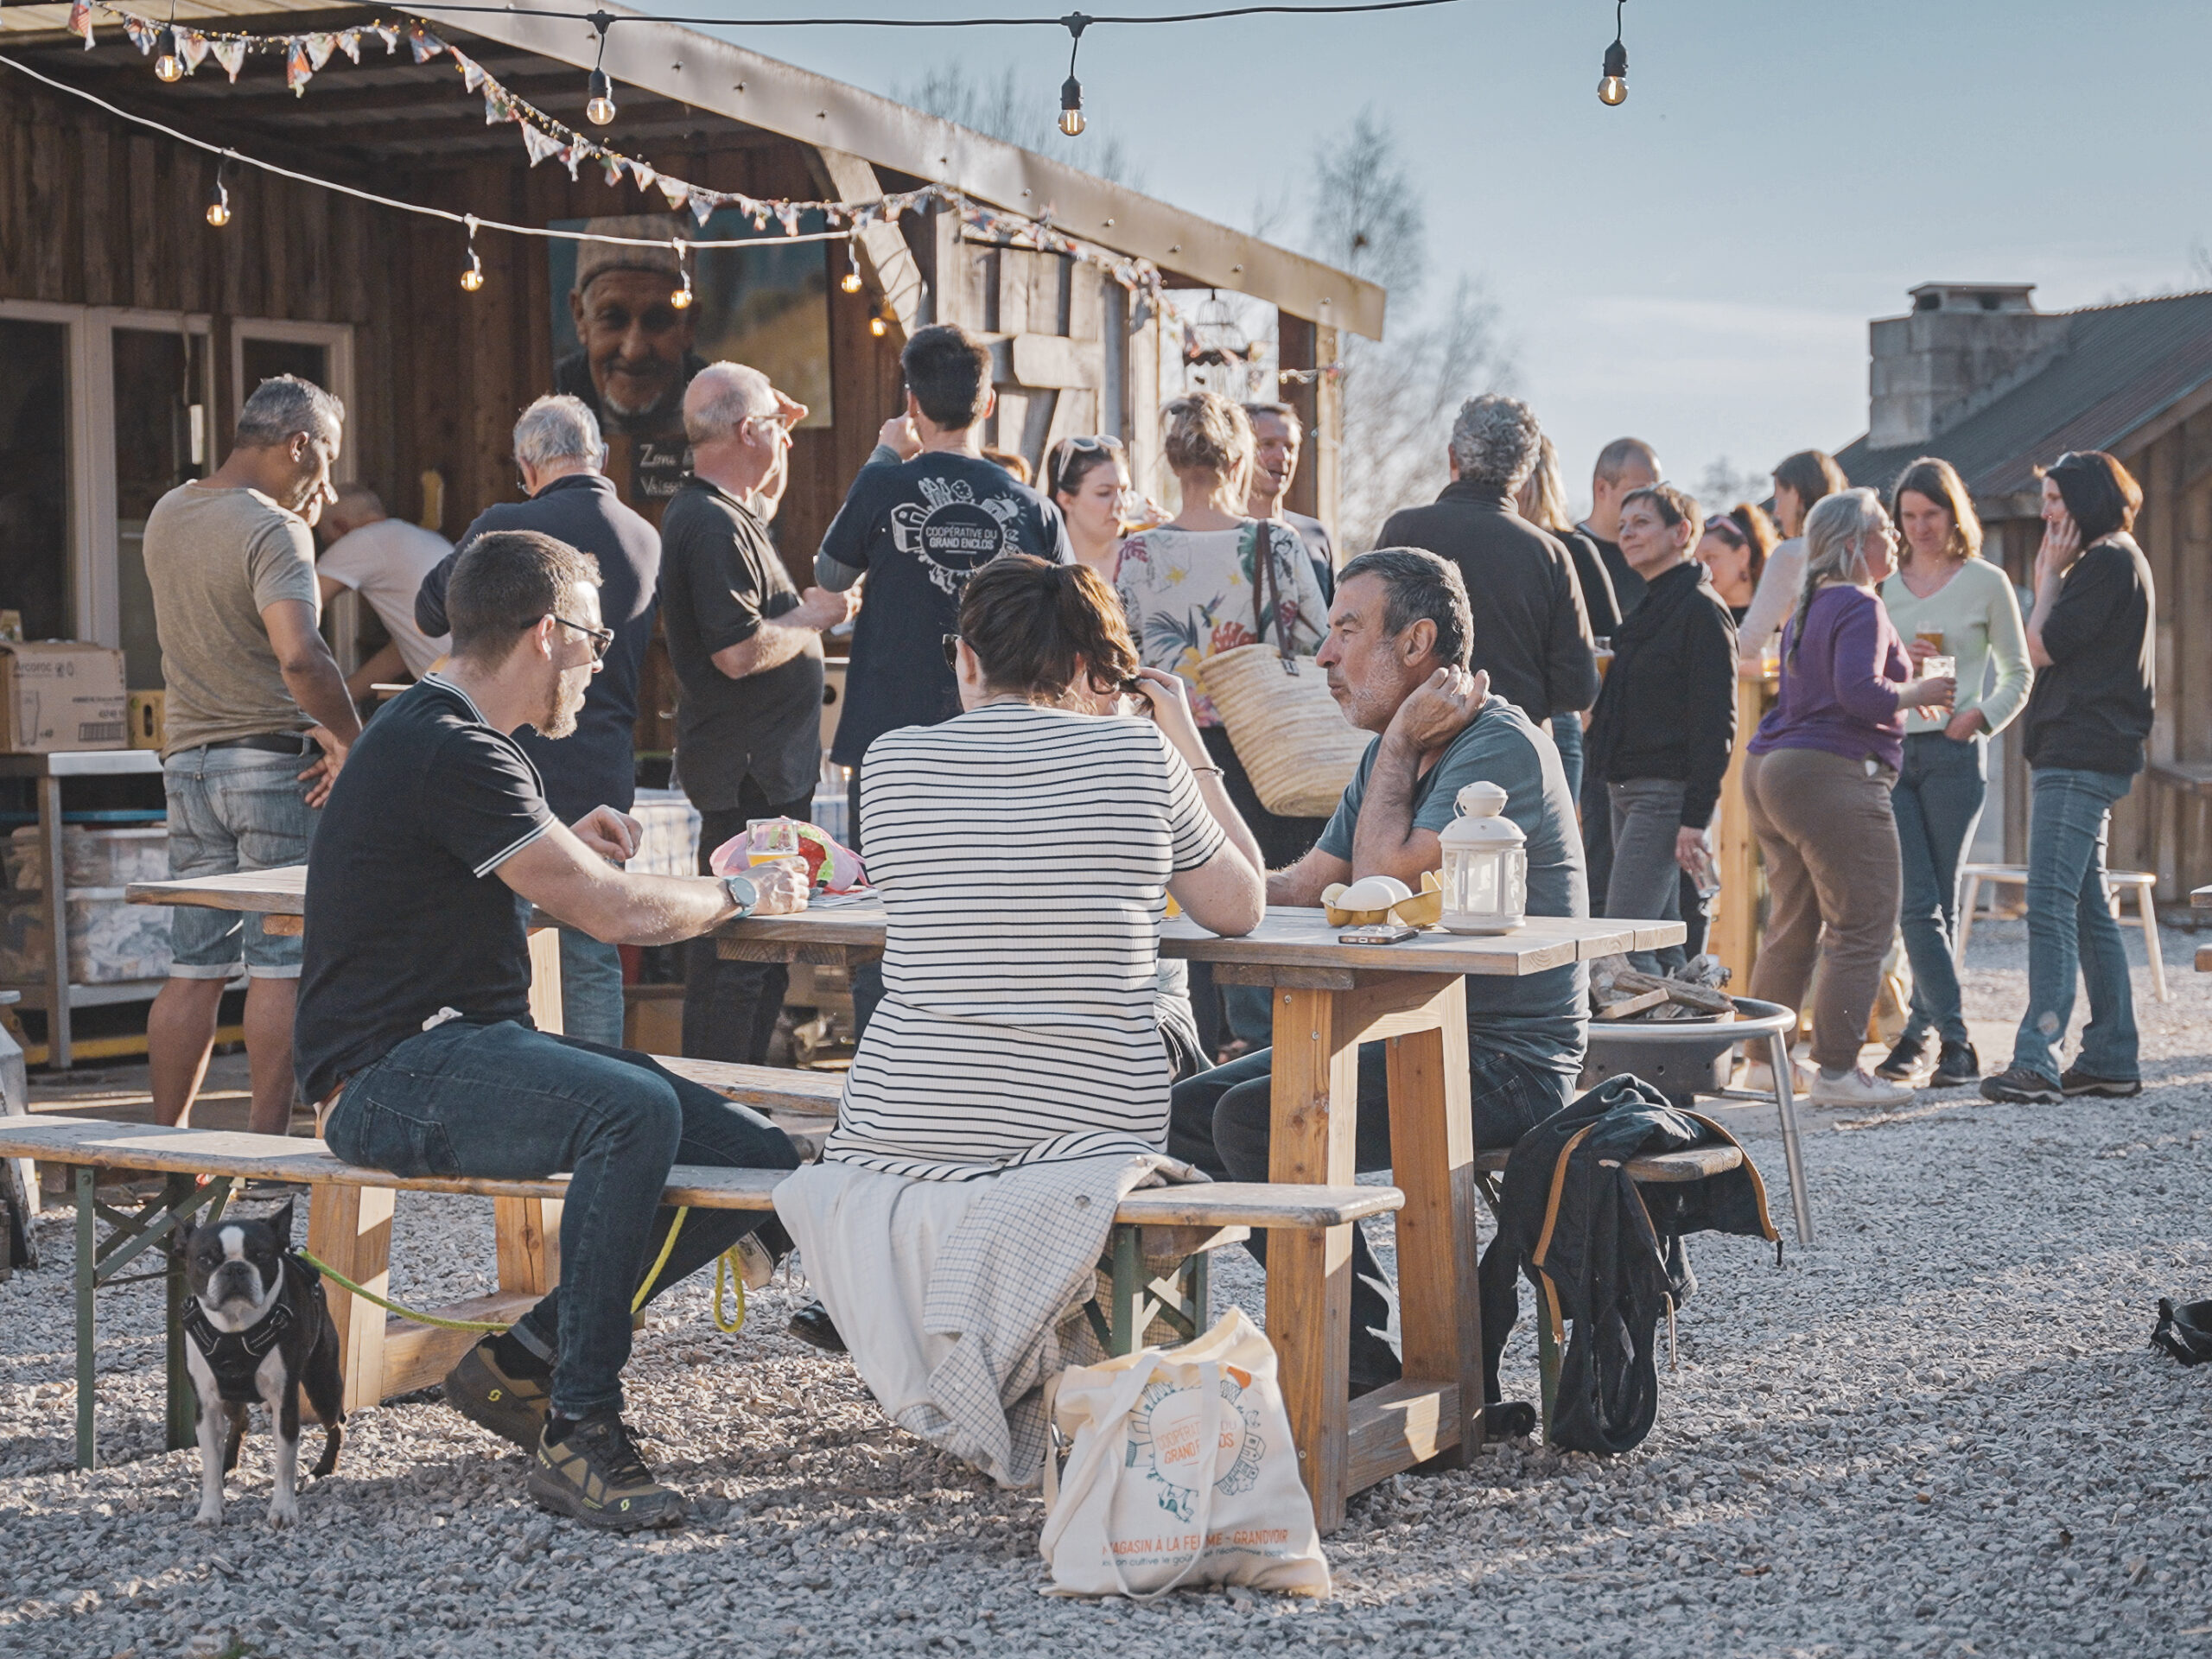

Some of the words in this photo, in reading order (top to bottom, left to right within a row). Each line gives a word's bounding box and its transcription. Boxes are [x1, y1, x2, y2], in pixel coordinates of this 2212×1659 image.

[639, 443, 677, 467] Zone
[925, 526, 982, 538] COOPÉRATIVE
[984, 529, 998, 539] DU
[929, 537, 960, 549] GRAND
[961, 537, 995, 550] ENCLOS
[1155, 1421, 1202, 1451] COOPÉRAT
[1164, 1441, 1196, 1464] GRAND
[1155, 1534, 1163, 1552] À
[1166, 1537, 1179, 1552] LA
[1233, 1529, 1288, 1546] GRANDVOIR
